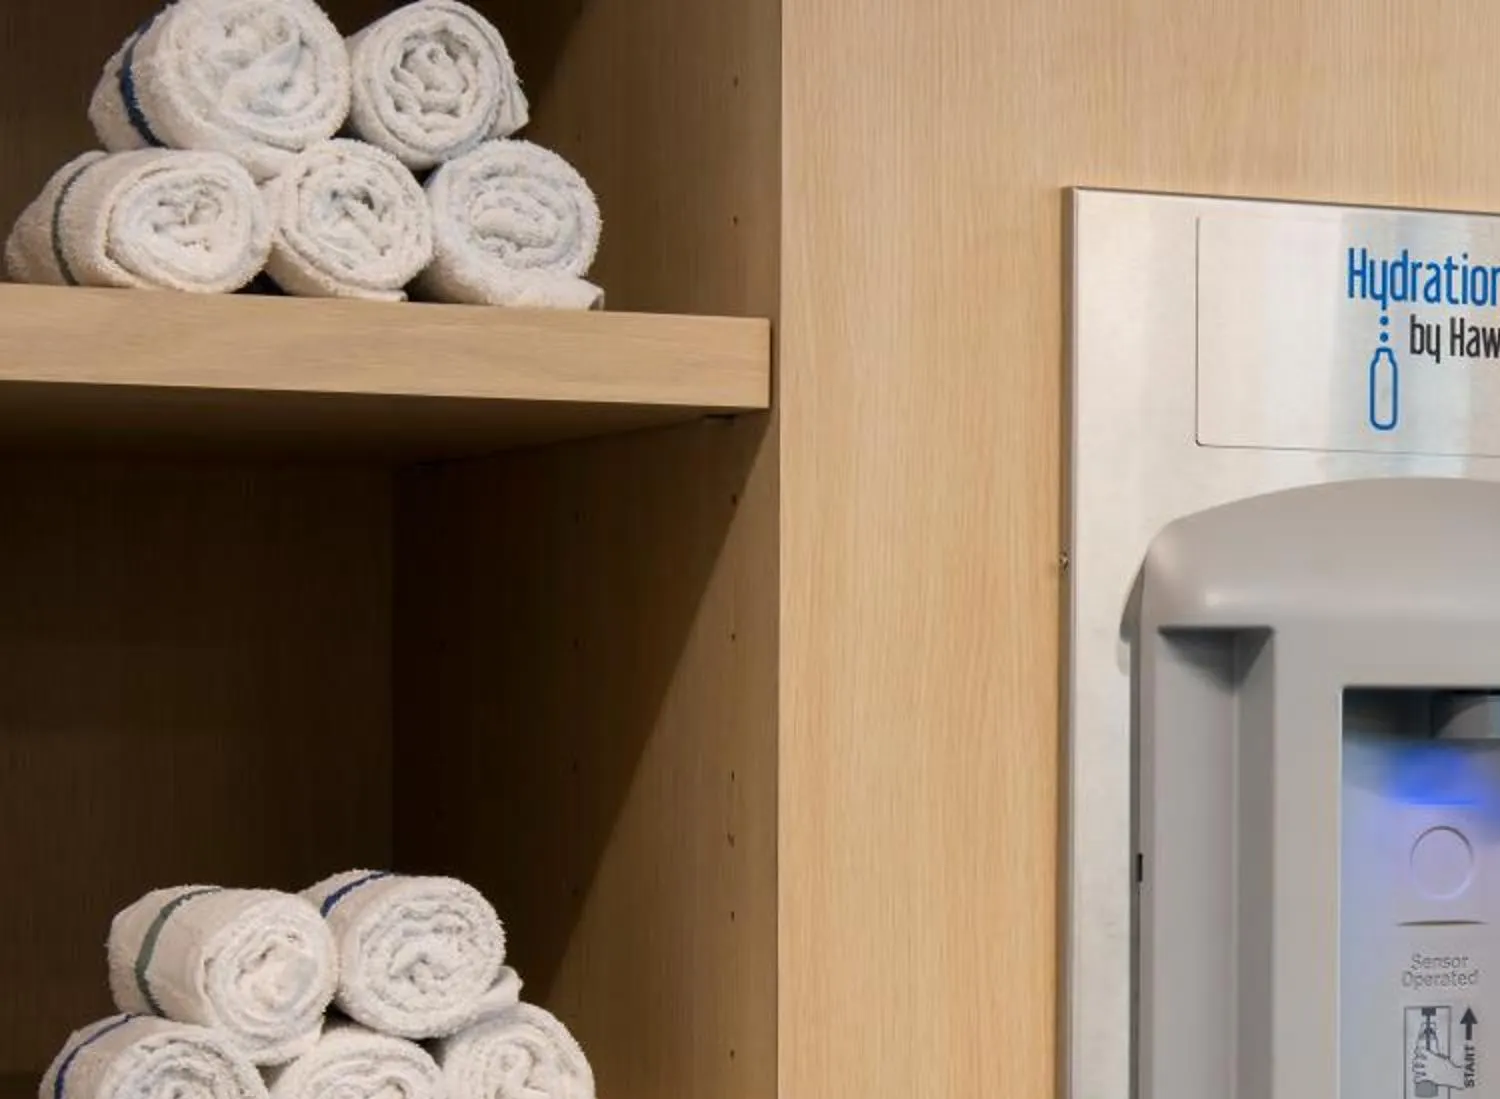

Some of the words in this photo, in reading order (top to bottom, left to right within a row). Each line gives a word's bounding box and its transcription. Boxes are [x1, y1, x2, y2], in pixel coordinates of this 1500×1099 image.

[1409, 314, 1441, 364] by
[1410, 953, 1469, 970] Sensor
[1401, 969, 1479, 991] Operated
[1464, 1044, 1475, 1088] START
